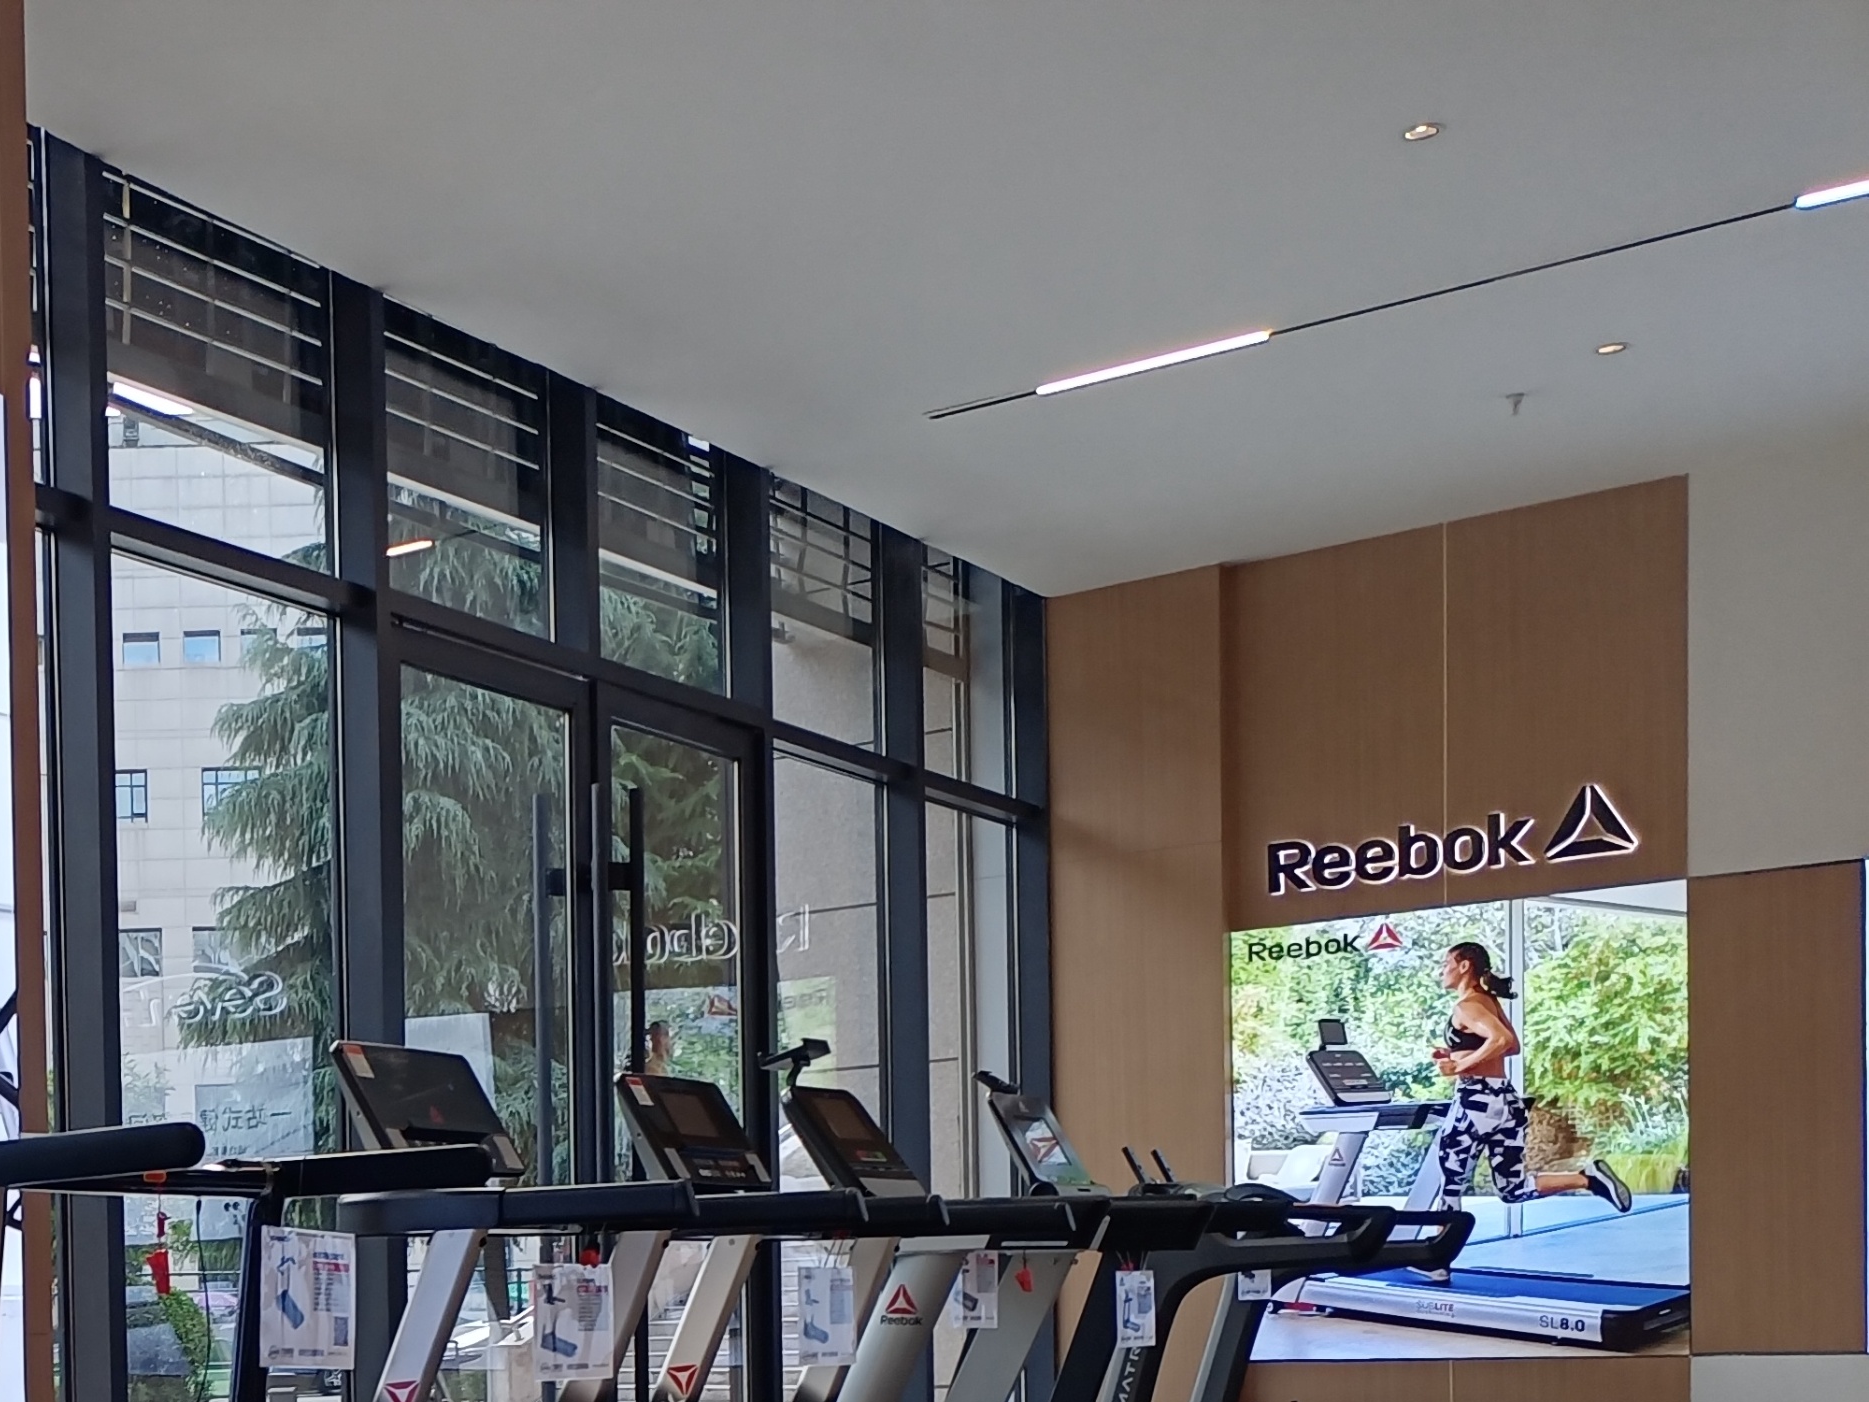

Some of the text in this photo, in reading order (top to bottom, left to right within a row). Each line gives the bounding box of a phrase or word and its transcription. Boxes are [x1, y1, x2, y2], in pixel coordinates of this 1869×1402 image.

[1267, 813, 1535, 896] Reebok
[1247, 932, 1361, 963] Reebok
[880, 1314, 924, 1327] Reebok
